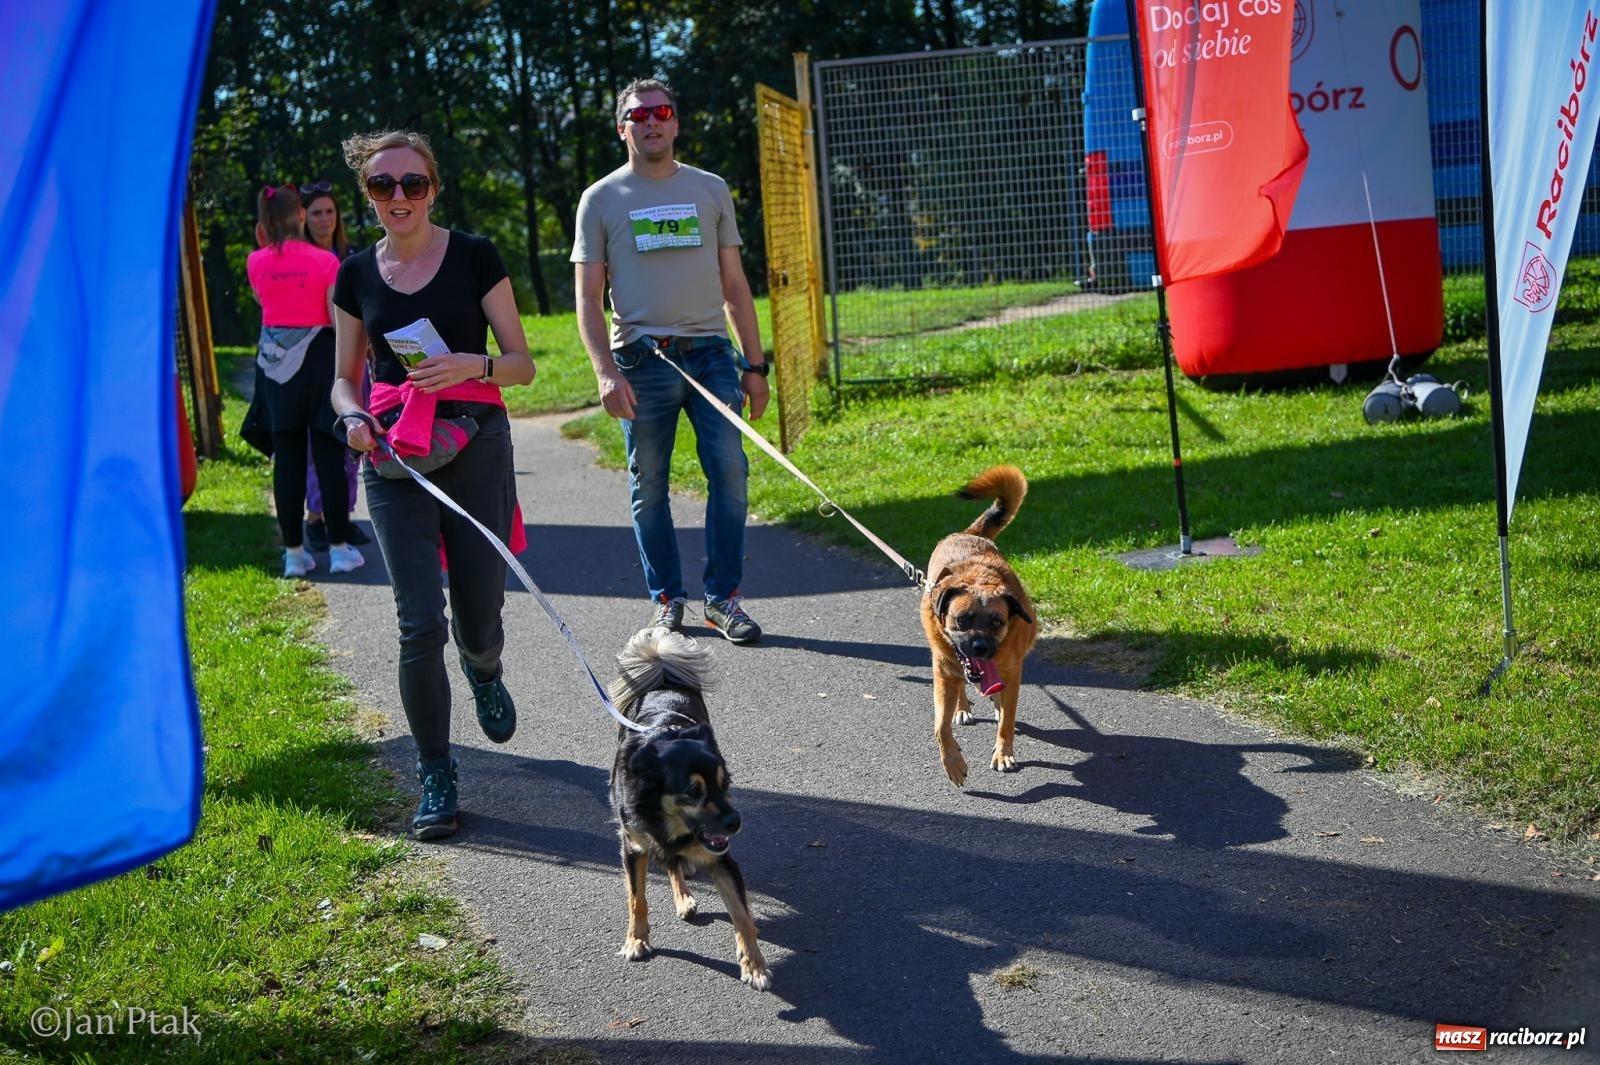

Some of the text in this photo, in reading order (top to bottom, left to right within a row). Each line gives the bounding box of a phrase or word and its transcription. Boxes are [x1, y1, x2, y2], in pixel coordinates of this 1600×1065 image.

[1150, 0, 1229, 32] Dodaj
[1153, 28, 1252, 69] od siebie
[1536, 9, 1598, 240] Racibórz
[653, 219, 680, 234] 79
